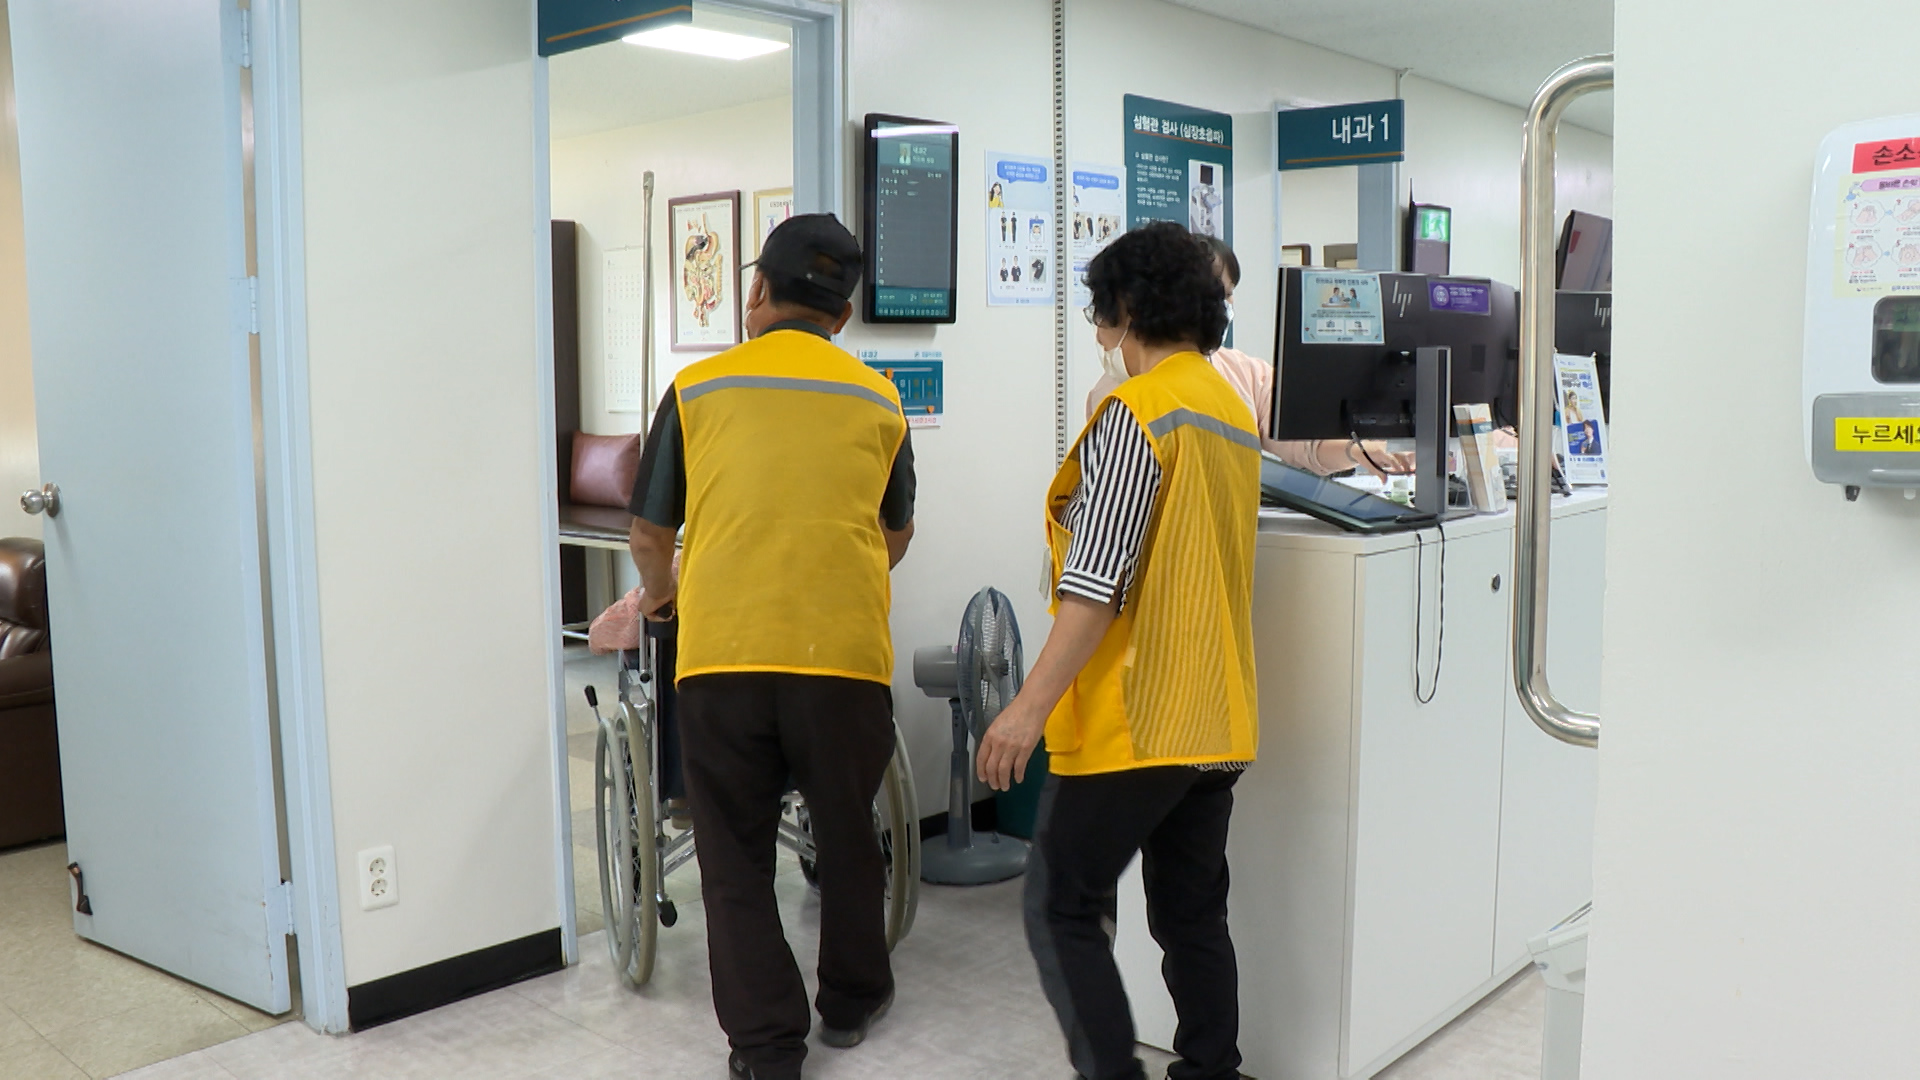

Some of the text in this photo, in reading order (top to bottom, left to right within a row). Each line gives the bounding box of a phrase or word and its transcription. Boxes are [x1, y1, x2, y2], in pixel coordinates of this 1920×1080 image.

[1133, 114, 1224, 146] 심혈관 검사 (심장초음파)
[1332, 113, 1389, 144] 내과 1
[1872, 145, 1920, 166] 손소
[1392, 280, 1412, 317] hp
[1852, 424, 1920, 445] 누르세
